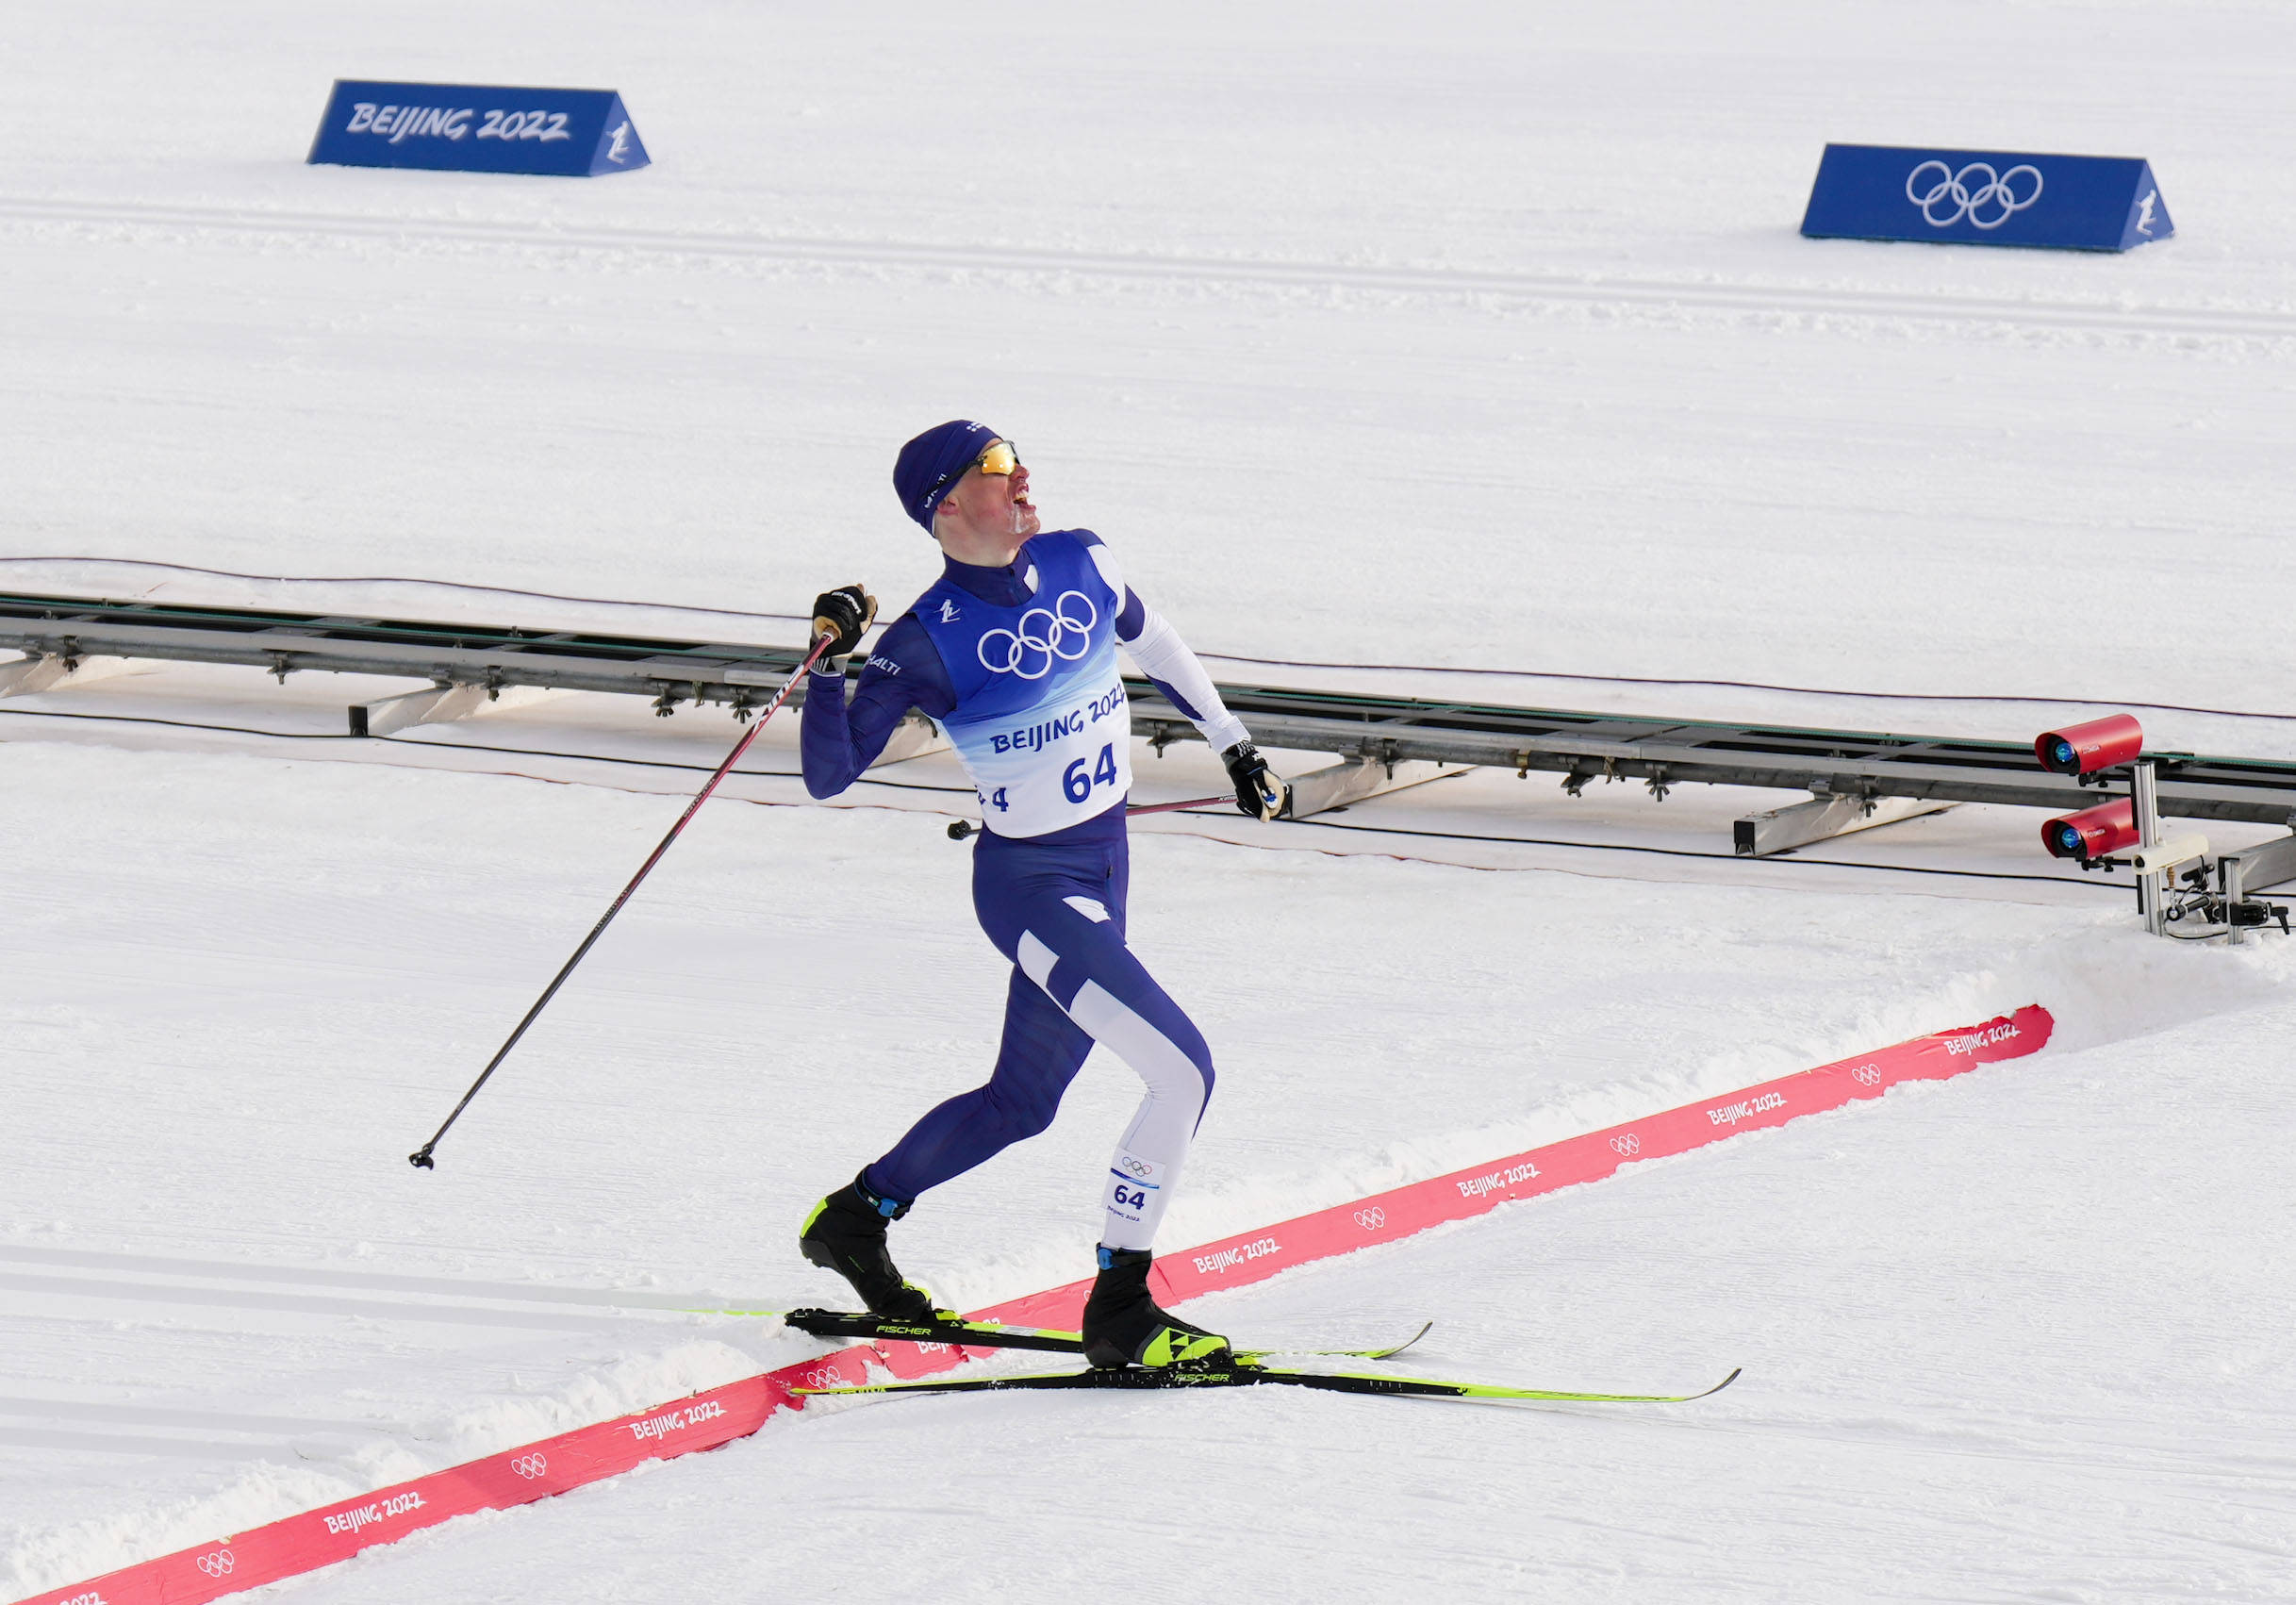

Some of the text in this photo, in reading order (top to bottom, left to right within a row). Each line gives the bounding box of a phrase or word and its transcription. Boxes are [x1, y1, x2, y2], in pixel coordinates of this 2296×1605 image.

[346, 102, 570, 144] BEIJING 2022
[990, 683, 1125, 754] BEIJING 2022
[1063, 742, 1116, 804] 64
[1943, 1031, 1989, 1056] BEIJING
[1707, 1092, 1788, 1126] BEIJING 2022
[1115, 1184, 1146, 1210] 64
[1456, 1163, 1543, 1198] BEIJING 2022
[1192, 1237, 1282, 1274] BEIJING 2022
[876, 1325, 932, 1336] FISCHER
[1175, 1373, 1231, 1382] FISCHER
[629, 1400, 728, 1440] BEIJING 2022
[323, 1491, 428, 1534] BEIJING 2022
